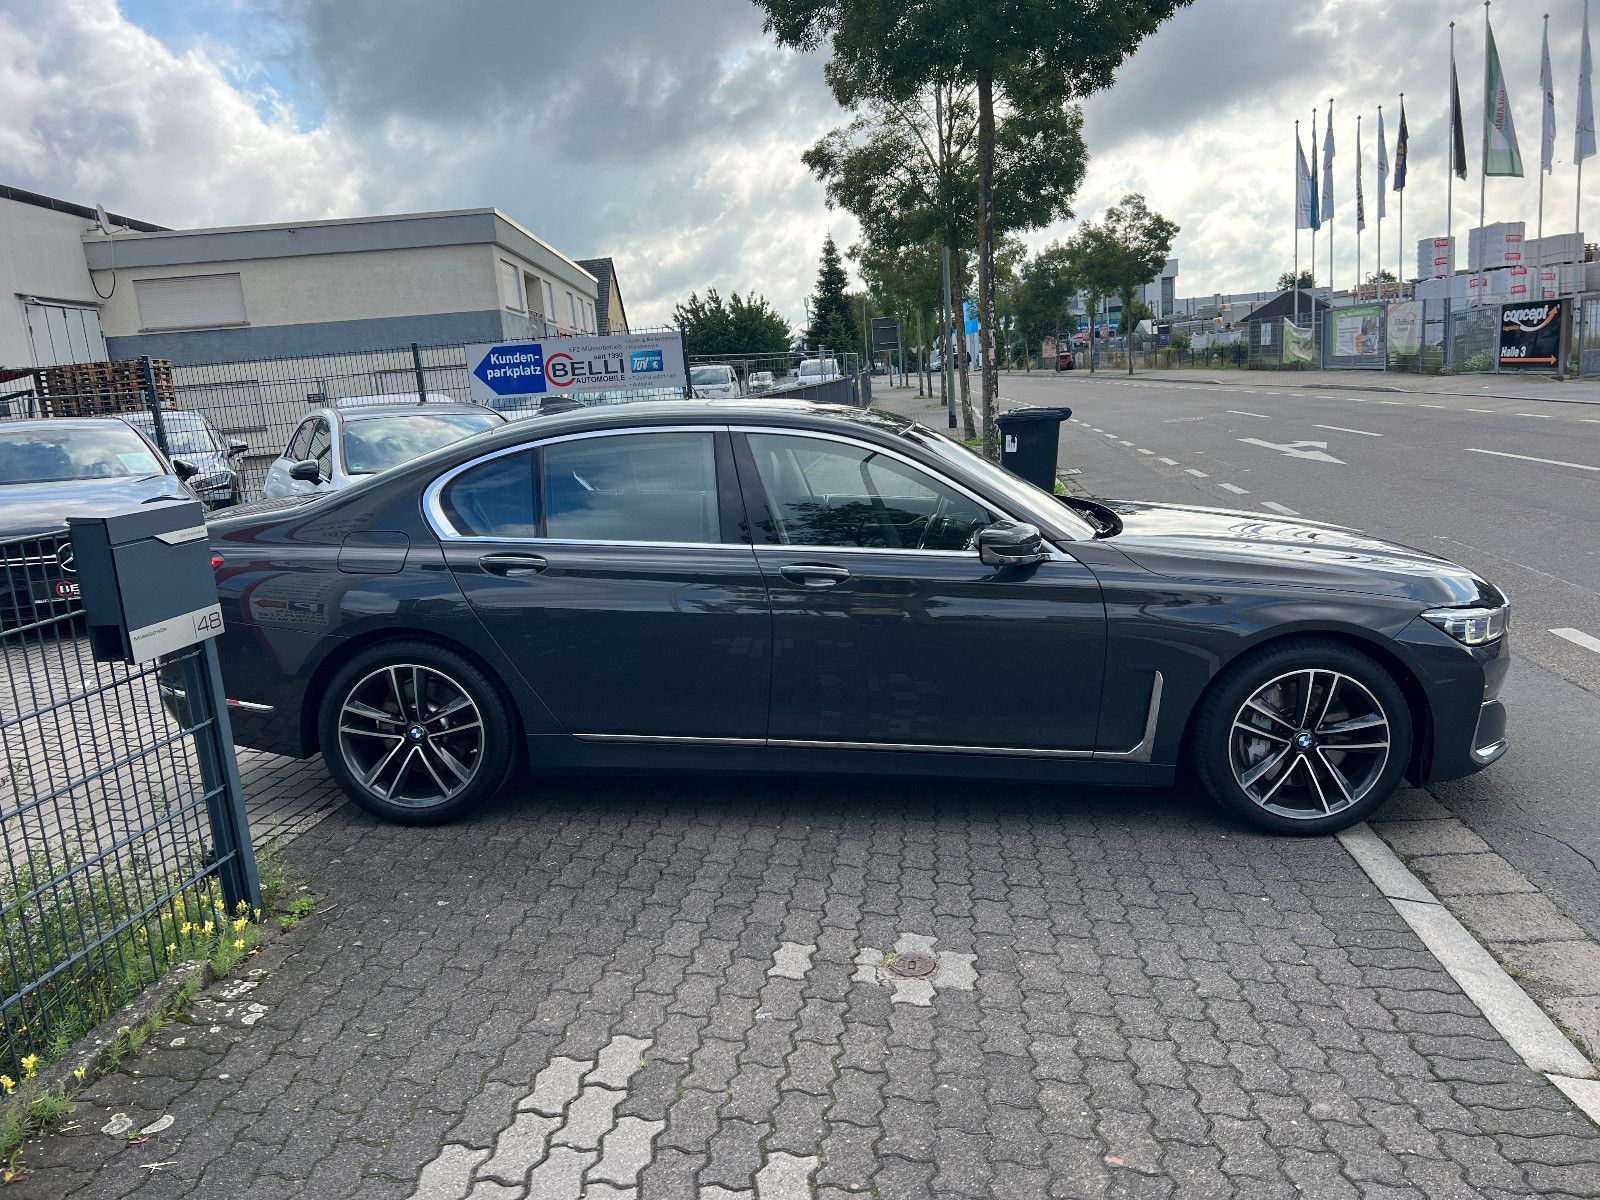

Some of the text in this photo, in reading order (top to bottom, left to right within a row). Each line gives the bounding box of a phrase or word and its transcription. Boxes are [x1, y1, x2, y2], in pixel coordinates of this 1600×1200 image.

[1503, 304, 1549, 325] concept
[490, 352, 540, 365] Kunden-
[1501, 346, 1527, 357] Halle 3
[486, 365, 542, 380] parkplatz
[551, 359, 625, 378] BELLI
[576, 375, 626, 383] AUTOMOBILE
[197, 611, 222, 632] 48
